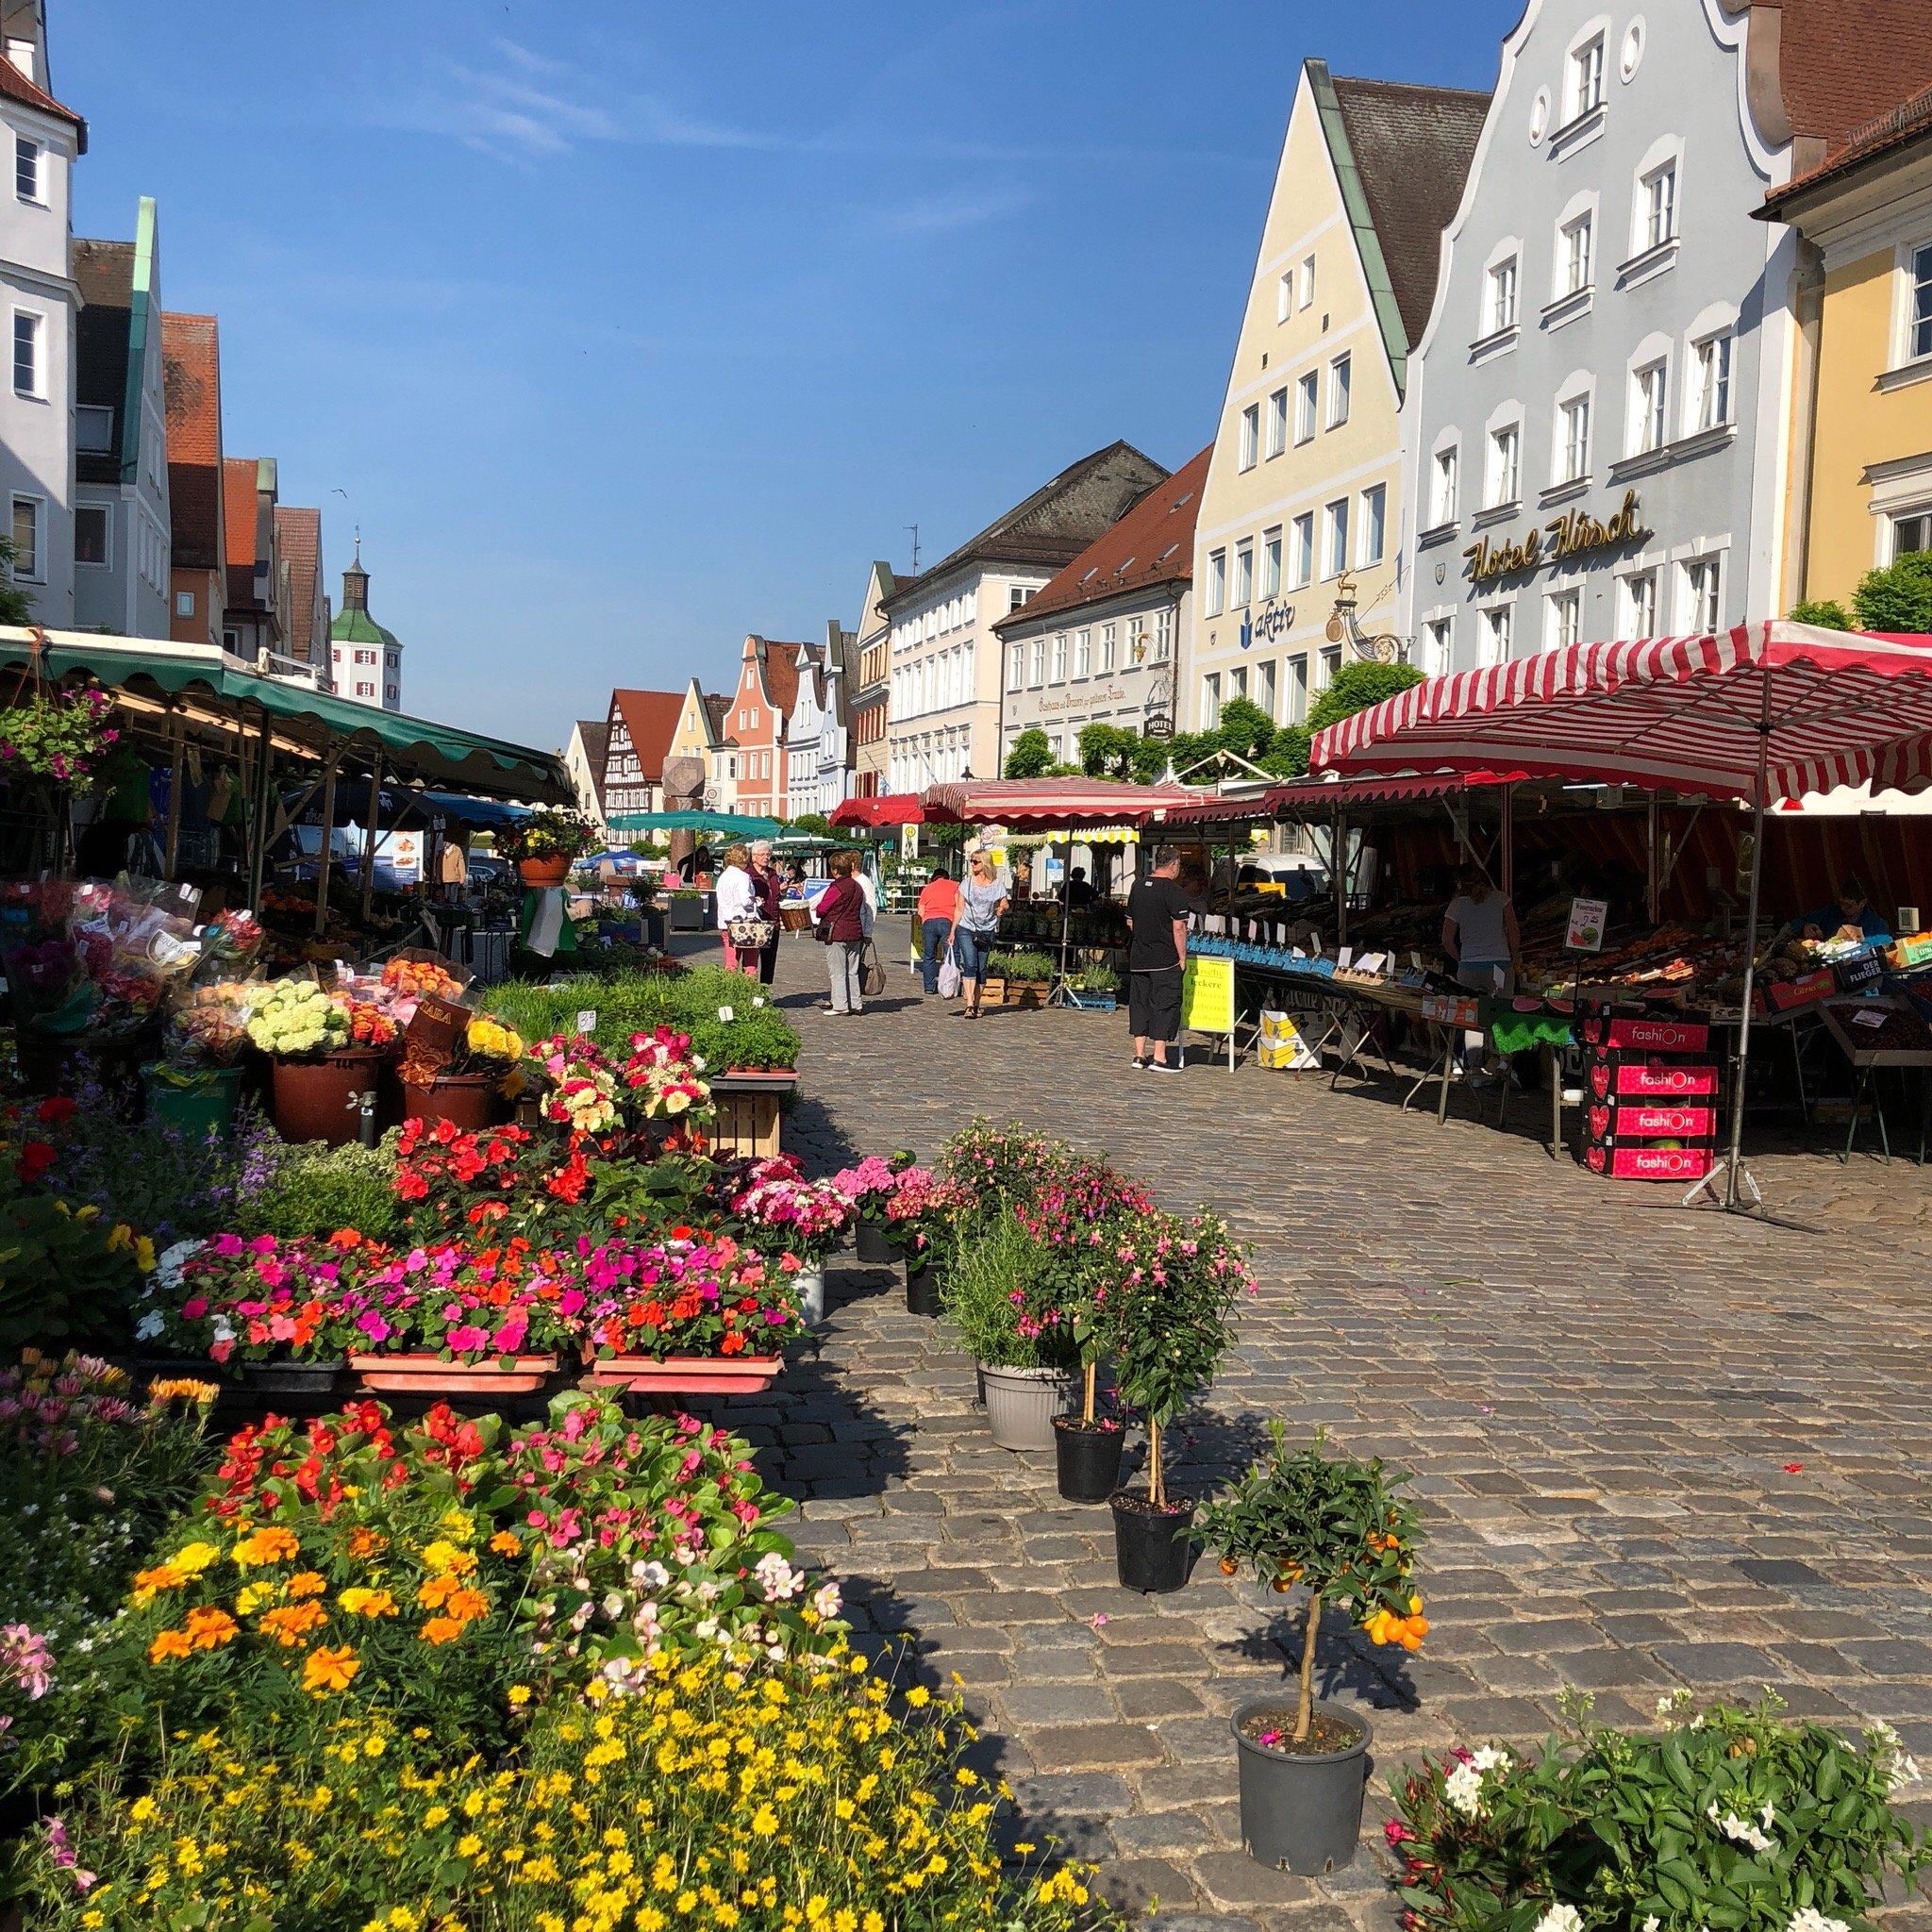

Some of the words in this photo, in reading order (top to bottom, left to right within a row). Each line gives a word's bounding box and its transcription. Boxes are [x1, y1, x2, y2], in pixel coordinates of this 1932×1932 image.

[1463, 528, 1540, 582] Hotel
[1545, 489, 1640, 559] Hirsch
[1255, 599, 1296, 643] aktiv
[1148, 720, 1173, 731] HOTEL
[1863, 959, 1880, 972] DER
[1850, 966, 1882, 983] FLIEGER
[1191, 977, 1222, 990] leckere
